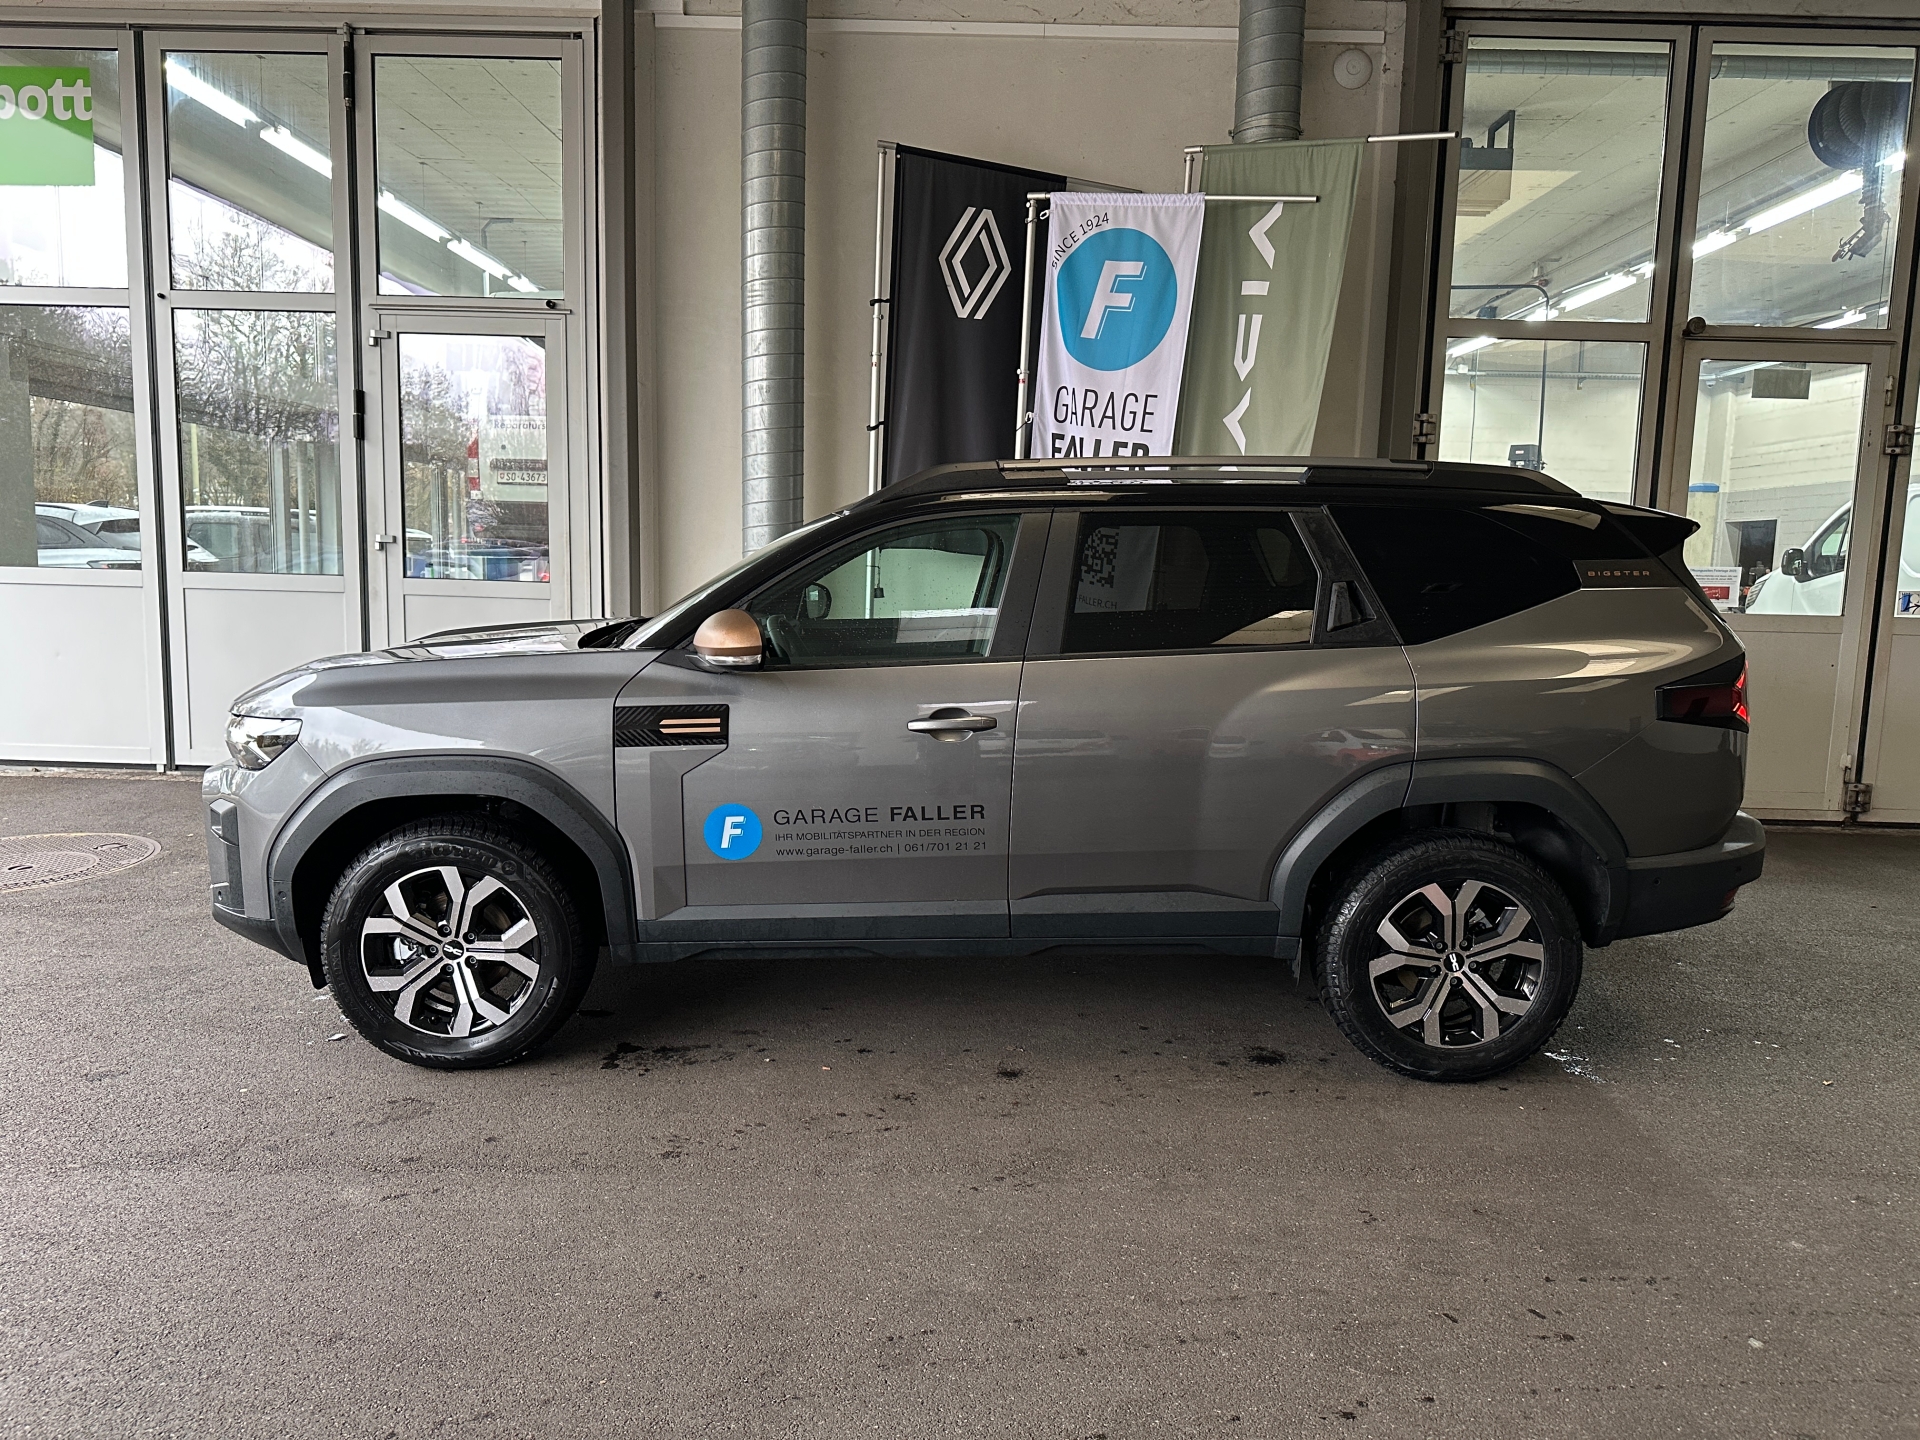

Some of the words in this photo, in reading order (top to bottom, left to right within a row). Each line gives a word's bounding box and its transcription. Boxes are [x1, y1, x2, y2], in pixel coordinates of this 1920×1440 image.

[1051, 231, 1080, 270] SINCE
[1079, 212, 1110, 236] 1924
[1081, 260, 1147, 339] F
[1053, 385, 1158, 433] GARAGE
[774, 807, 879, 825] GARAGE
[890, 804, 985, 822] FALLER
[720, 815, 746, 849] F
[775, 833, 793, 841] IHR
[796, 829, 903, 841] MOBILITÄTSPARTNER
[905, 829, 916, 838] IN
[919, 828, 941, 837] DER
[945, 827, 985, 836] REGION
[776, 843, 893, 857] www.garage-faller.ch
[904, 842, 950, 852] 061/701
[955, 842, 968, 850] 21
[973, 841, 986, 850] 21
